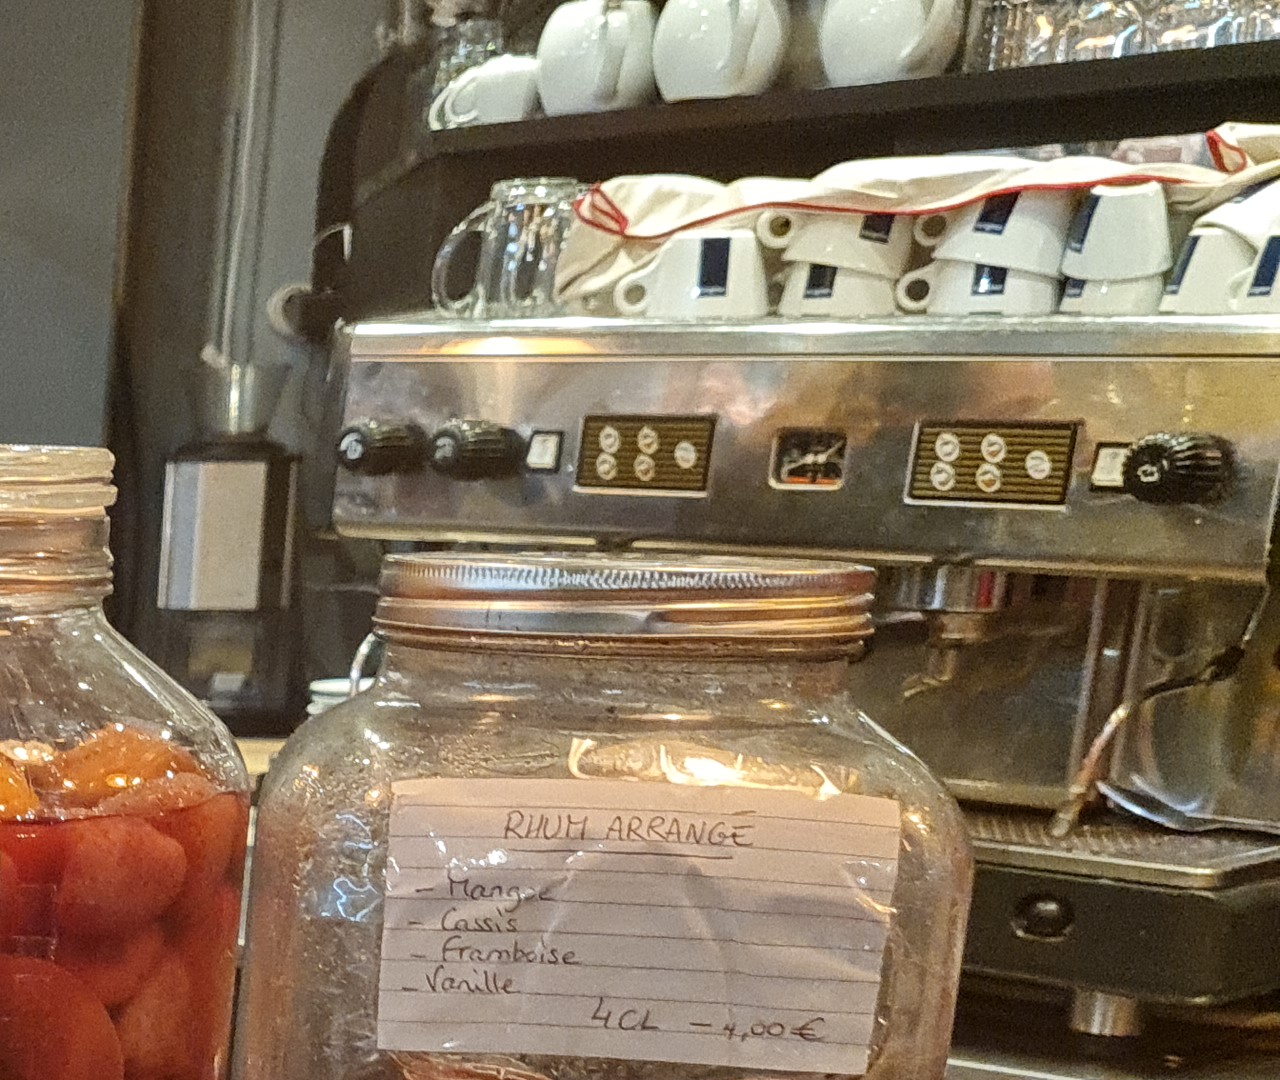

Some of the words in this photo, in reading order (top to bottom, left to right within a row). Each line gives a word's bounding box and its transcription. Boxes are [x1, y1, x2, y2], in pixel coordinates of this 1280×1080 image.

[504, 810, 588, 842] RHUM
[606, 811, 756, 847] ARRANGÉ
[441, 907, 519, 932] Cassis
[426, 965, 522, 995] Vanille
[590, 998, 659, 1033] 4CL
